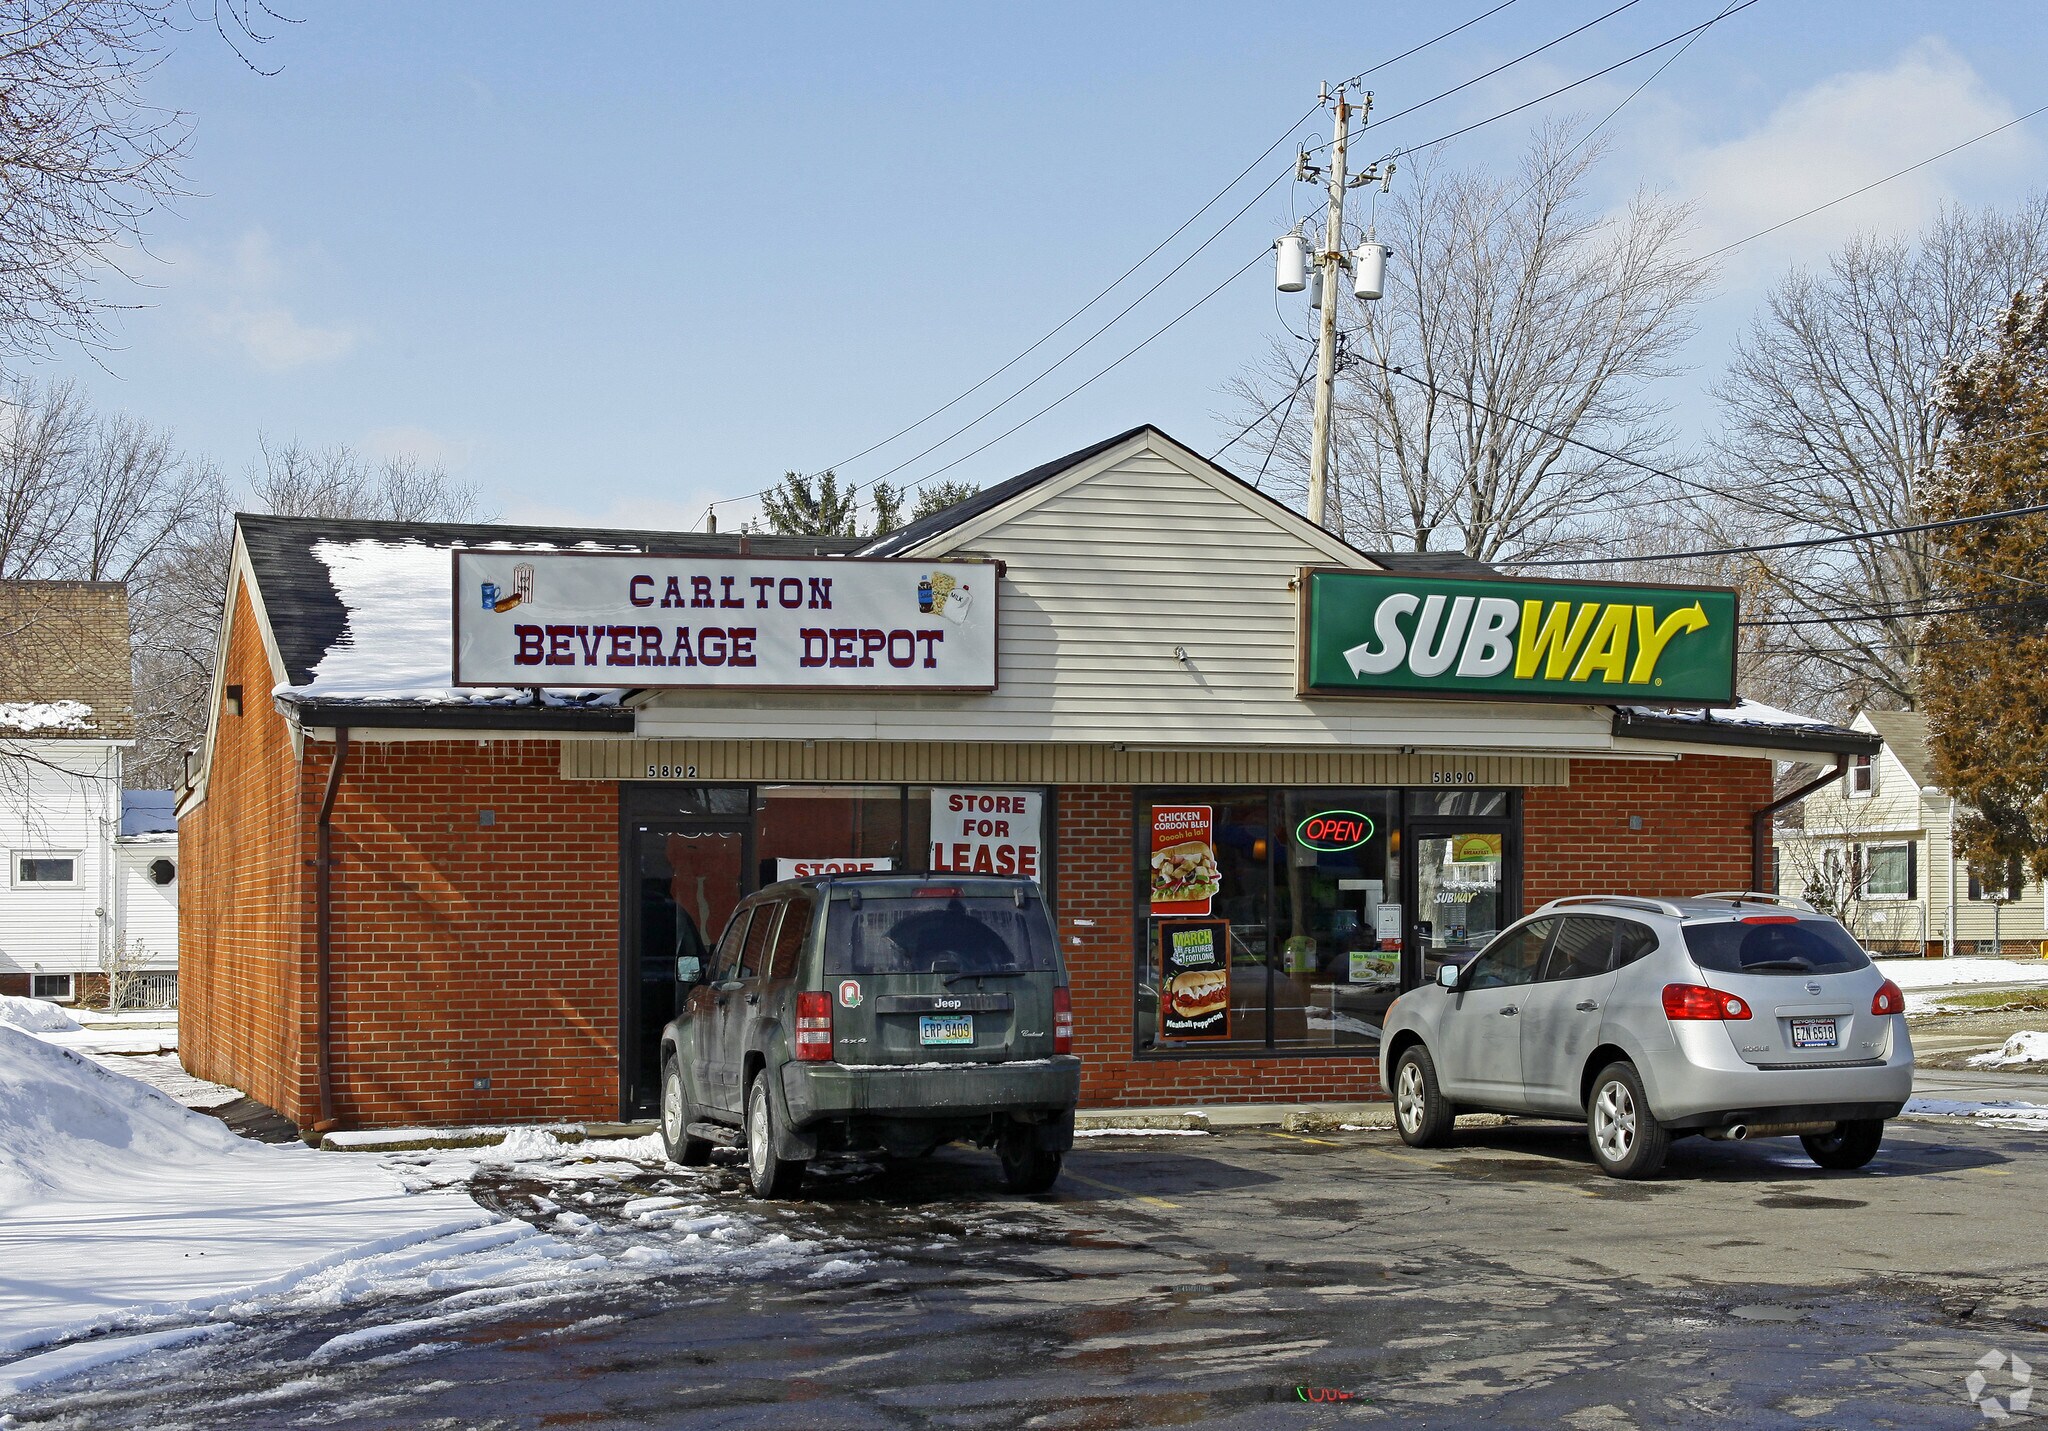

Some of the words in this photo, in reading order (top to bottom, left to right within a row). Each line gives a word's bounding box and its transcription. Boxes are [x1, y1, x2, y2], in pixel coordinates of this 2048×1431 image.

[629, 575, 833, 609] CARLTON
[514, 624, 757, 667] BEVERAGE
[799, 627, 945, 669] DEPOT
[1344, 593, 1709, 685] SUBWAY
[648, 765, 696, 778] 5892
[1433, 772, 1474, 783] 5890
[948, 794, 1026, 814] STORE
[1158, 811, 1200, 823] CHICKEN
[963, 819, 1010, 838] FOR
[1154, 821, 1189, 831] CORDON
[1190, 820, 1209, 829] BLEU
[1306, 818, 1364, 842] OPEN
[935, 843, 1037, 877] LEASE
[1433, 892, 1478, 904] SUBWAY
[1173, 929, 1213, 947] MARCH
[1184, 944, 1213, 954] FEATURED
[934, 998, 961, 1010] Jeep
[924, 1023, 942, 1038] ERP
[945, 1023, 970, 1038] 9409
[1796, 1027, 1812, 1041] EZN
[1813, 1026, 1834, 1040] 6518
